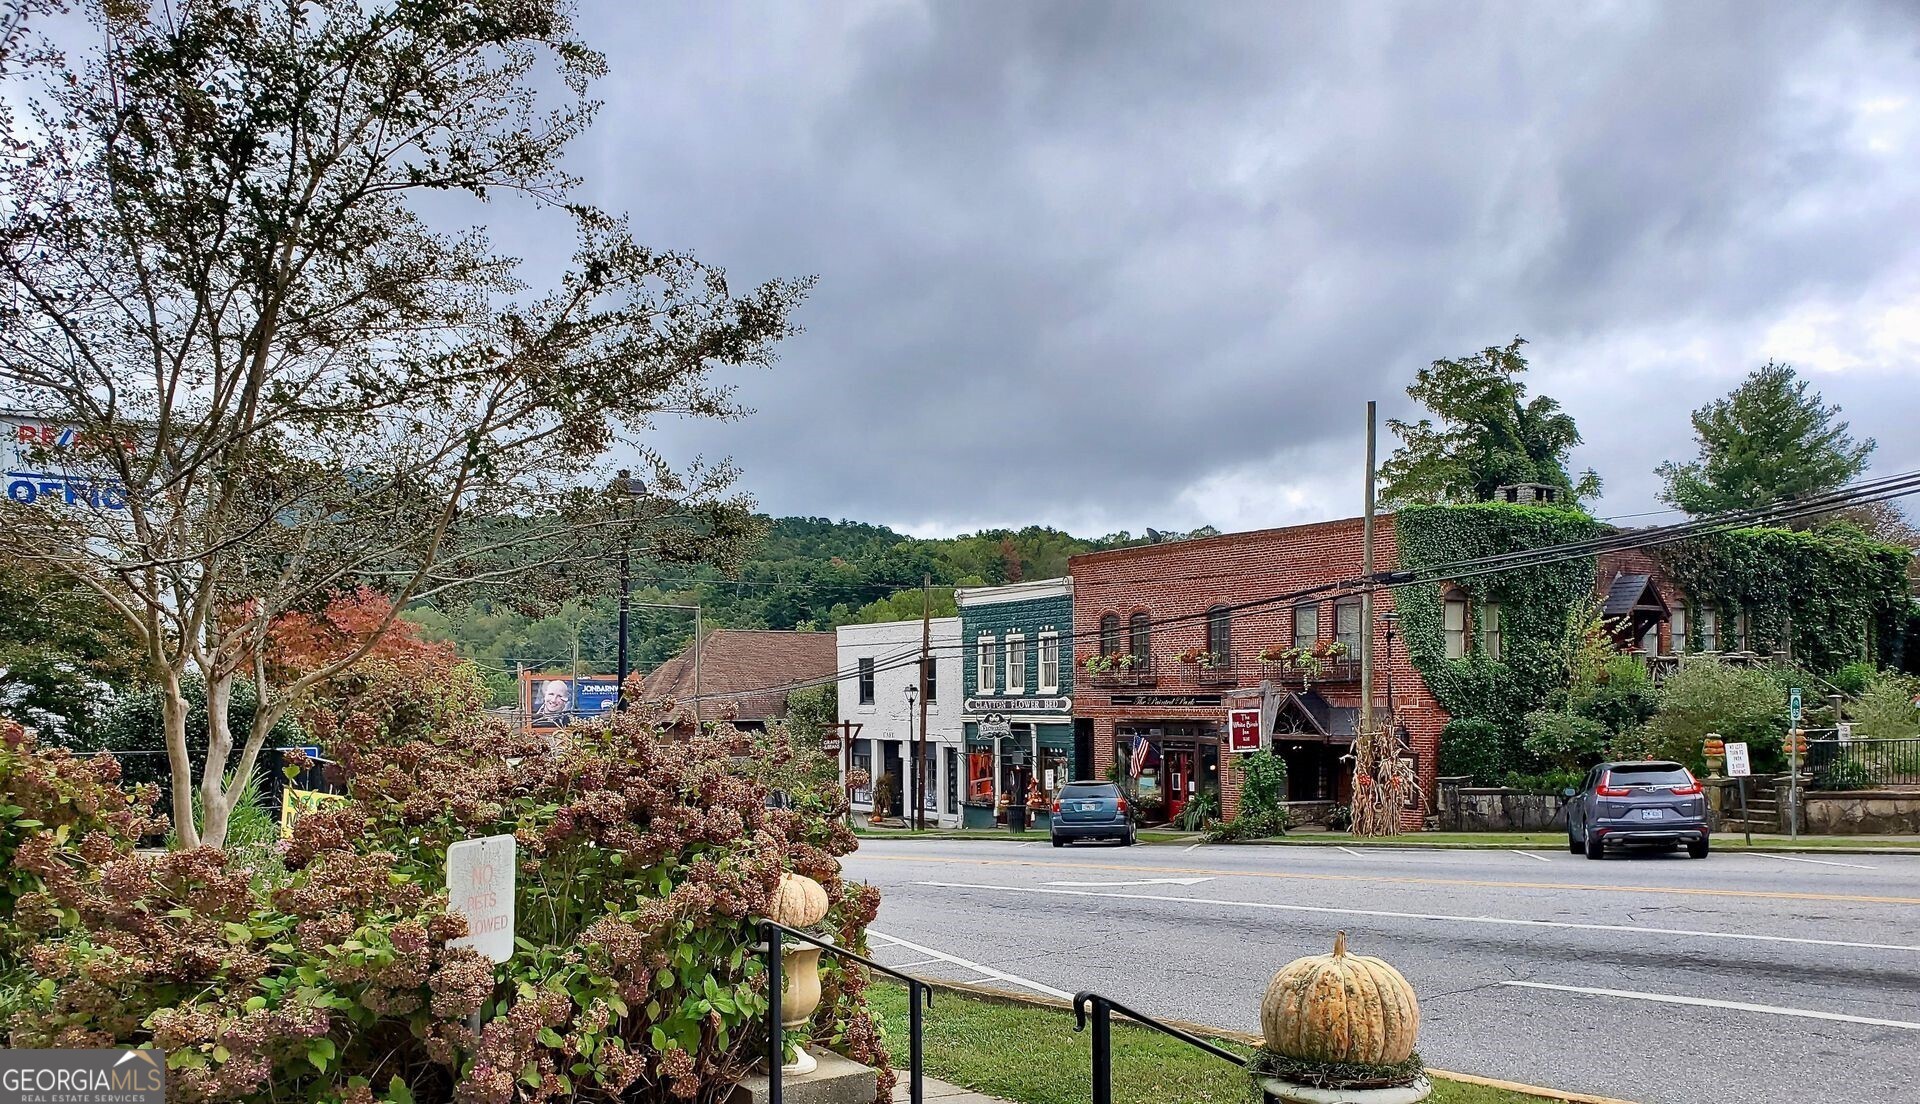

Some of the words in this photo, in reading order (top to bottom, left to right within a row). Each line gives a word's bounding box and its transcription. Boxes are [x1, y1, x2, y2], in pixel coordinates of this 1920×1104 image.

[8, 480, 153, 511] OFFIC
[975, 699, 1006, 710] CLAYTON
[1011, 699, 1039, 709] FLOWER
[1044, 699, 1059, 709] BED
[472, 864, 493, 885] NO
